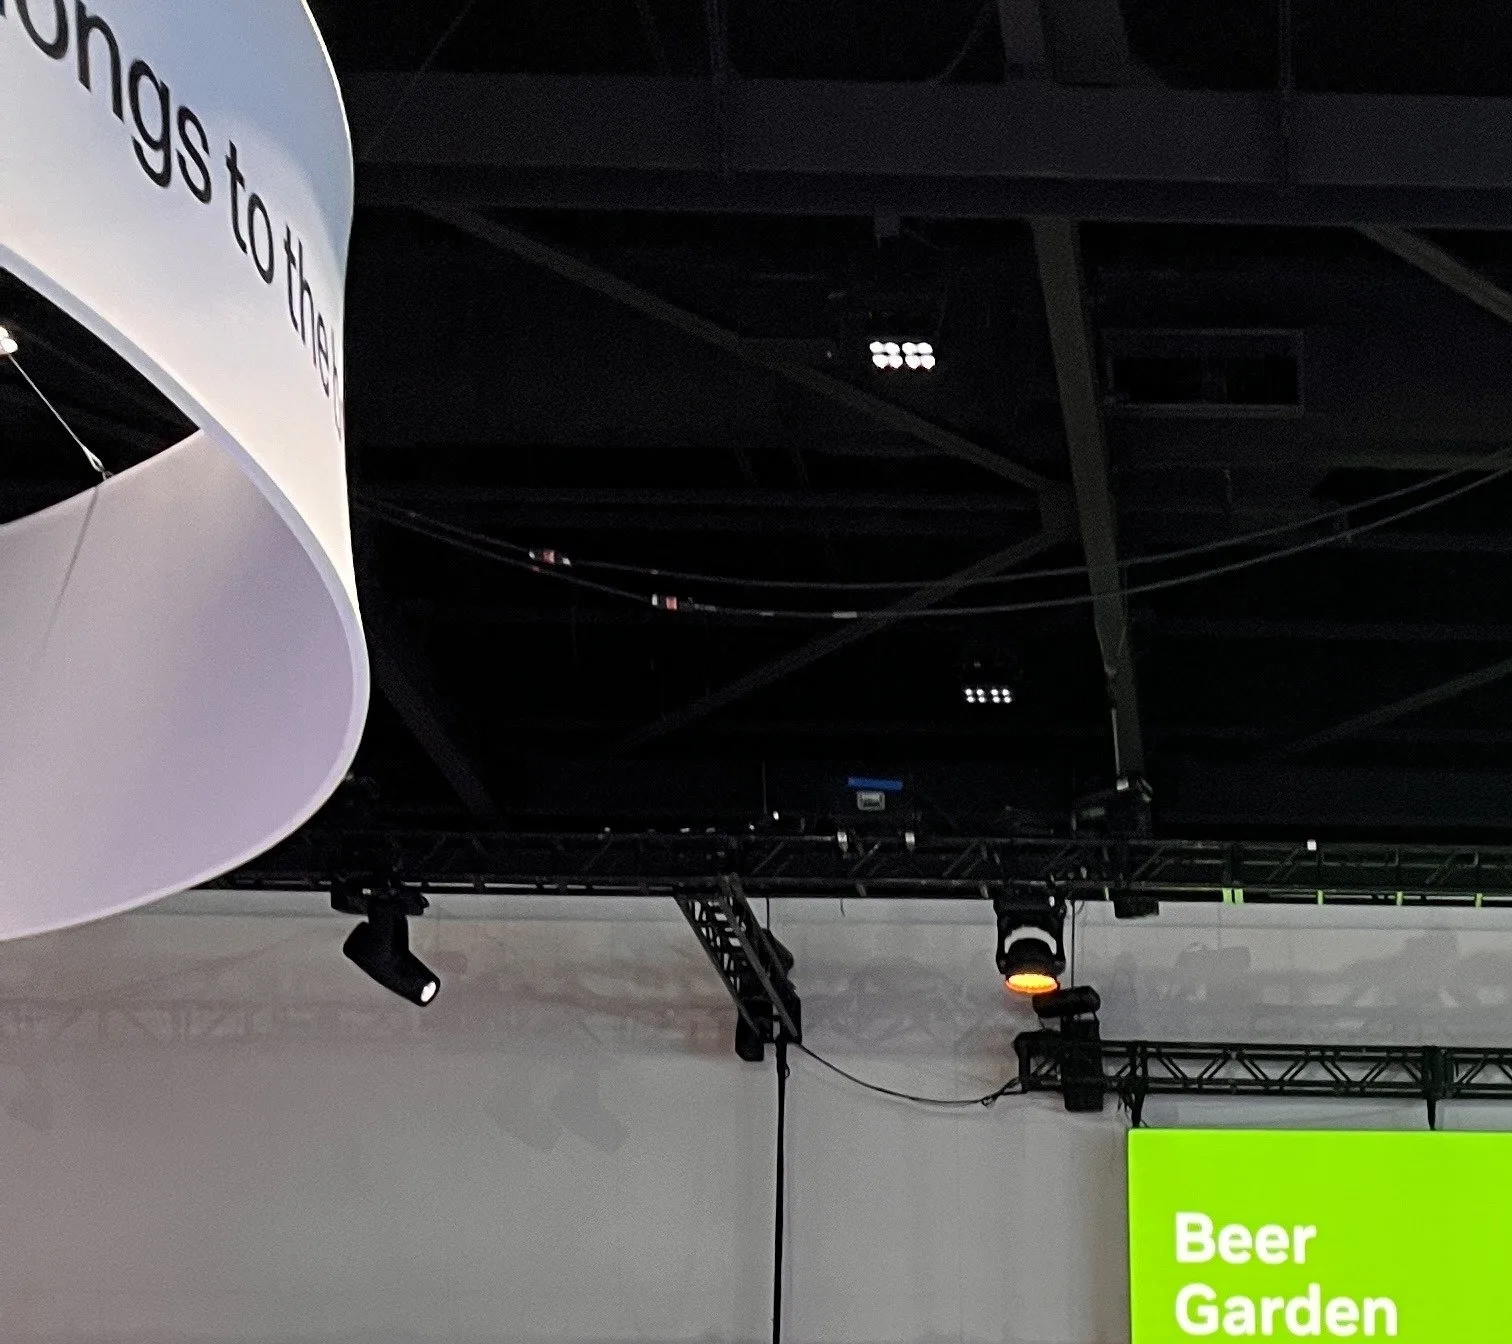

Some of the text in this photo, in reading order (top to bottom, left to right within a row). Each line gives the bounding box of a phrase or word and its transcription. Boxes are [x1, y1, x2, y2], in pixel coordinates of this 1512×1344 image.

[0, 0, 330, 398] ongs to the
[1175, 1212, 1316, 1264] Beer
[1175, 1283, 1398, 1336] Garden
